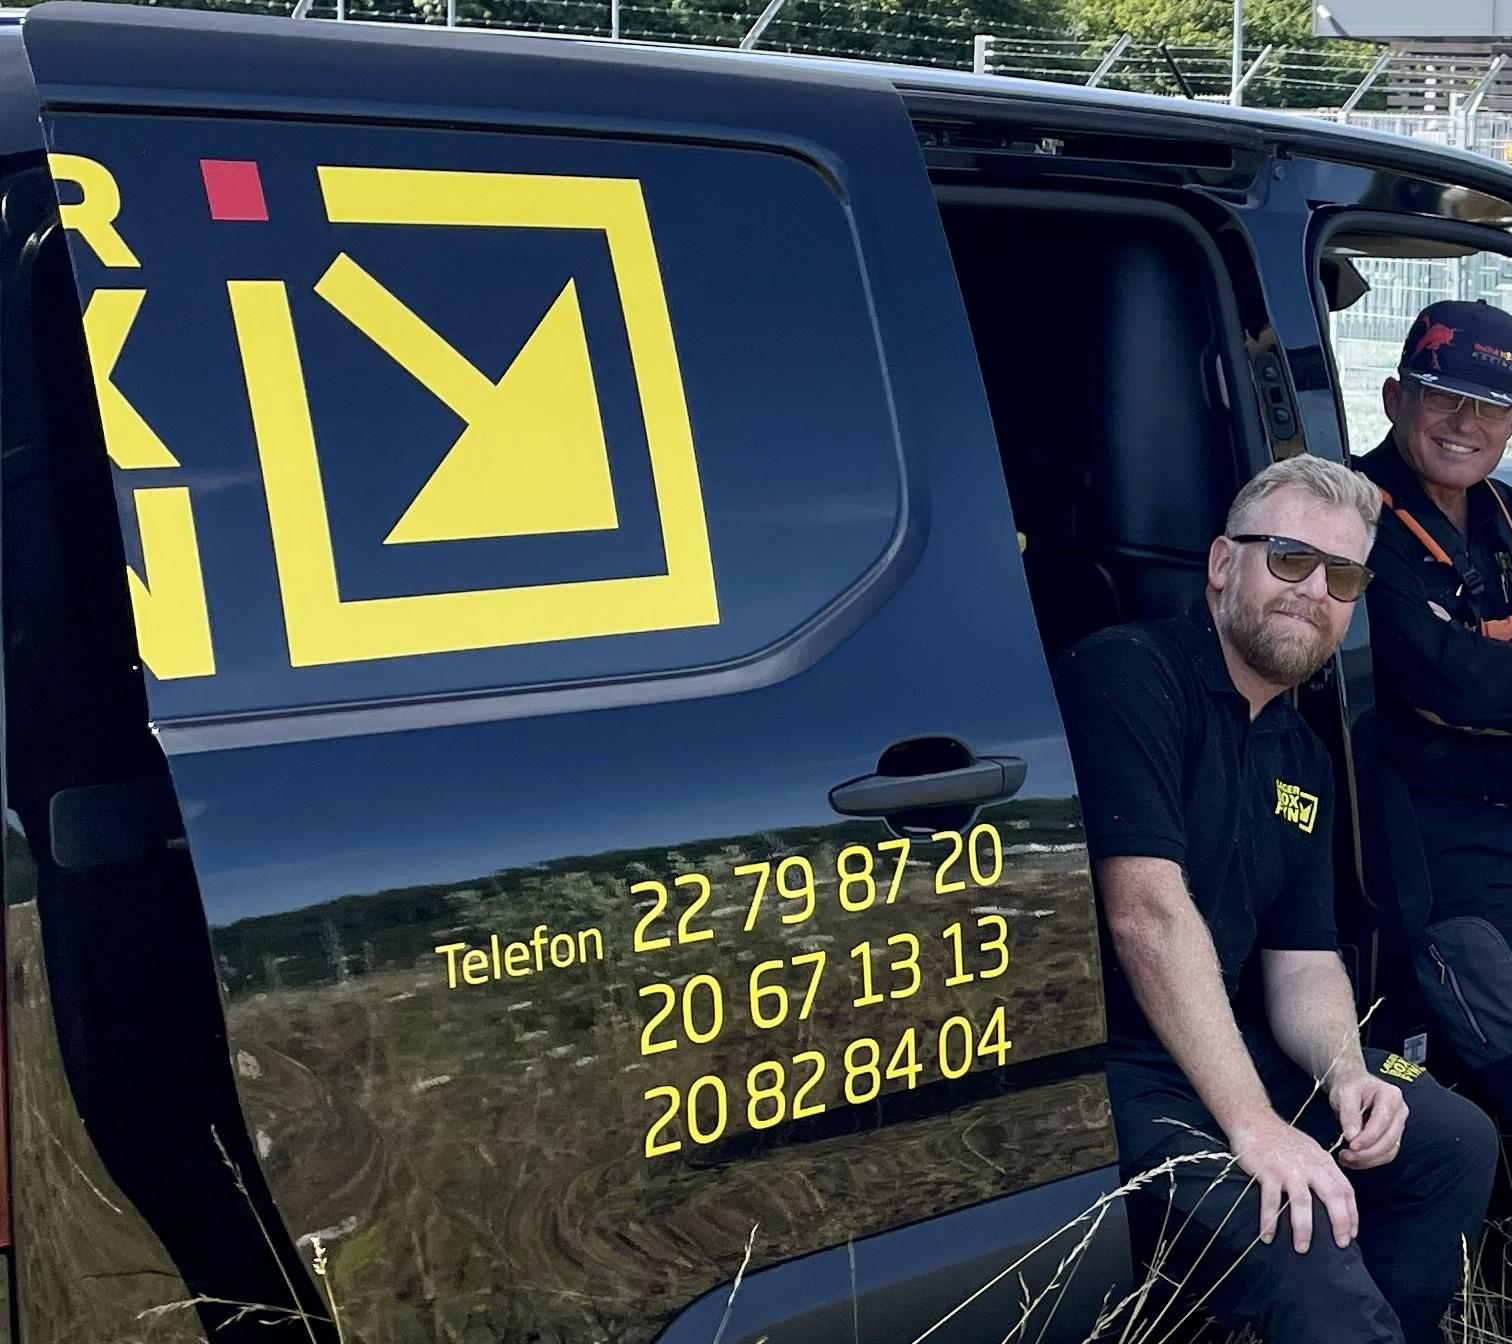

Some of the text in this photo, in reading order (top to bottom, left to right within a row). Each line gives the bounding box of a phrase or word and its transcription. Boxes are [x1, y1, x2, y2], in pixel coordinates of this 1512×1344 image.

[435, 823, 1004, 990] Telefon 22 79 87 20
[639, 913, 1010, 1056] 20 67 13 13
[644, 1006, 1012, 1158] 20 82 84 04
